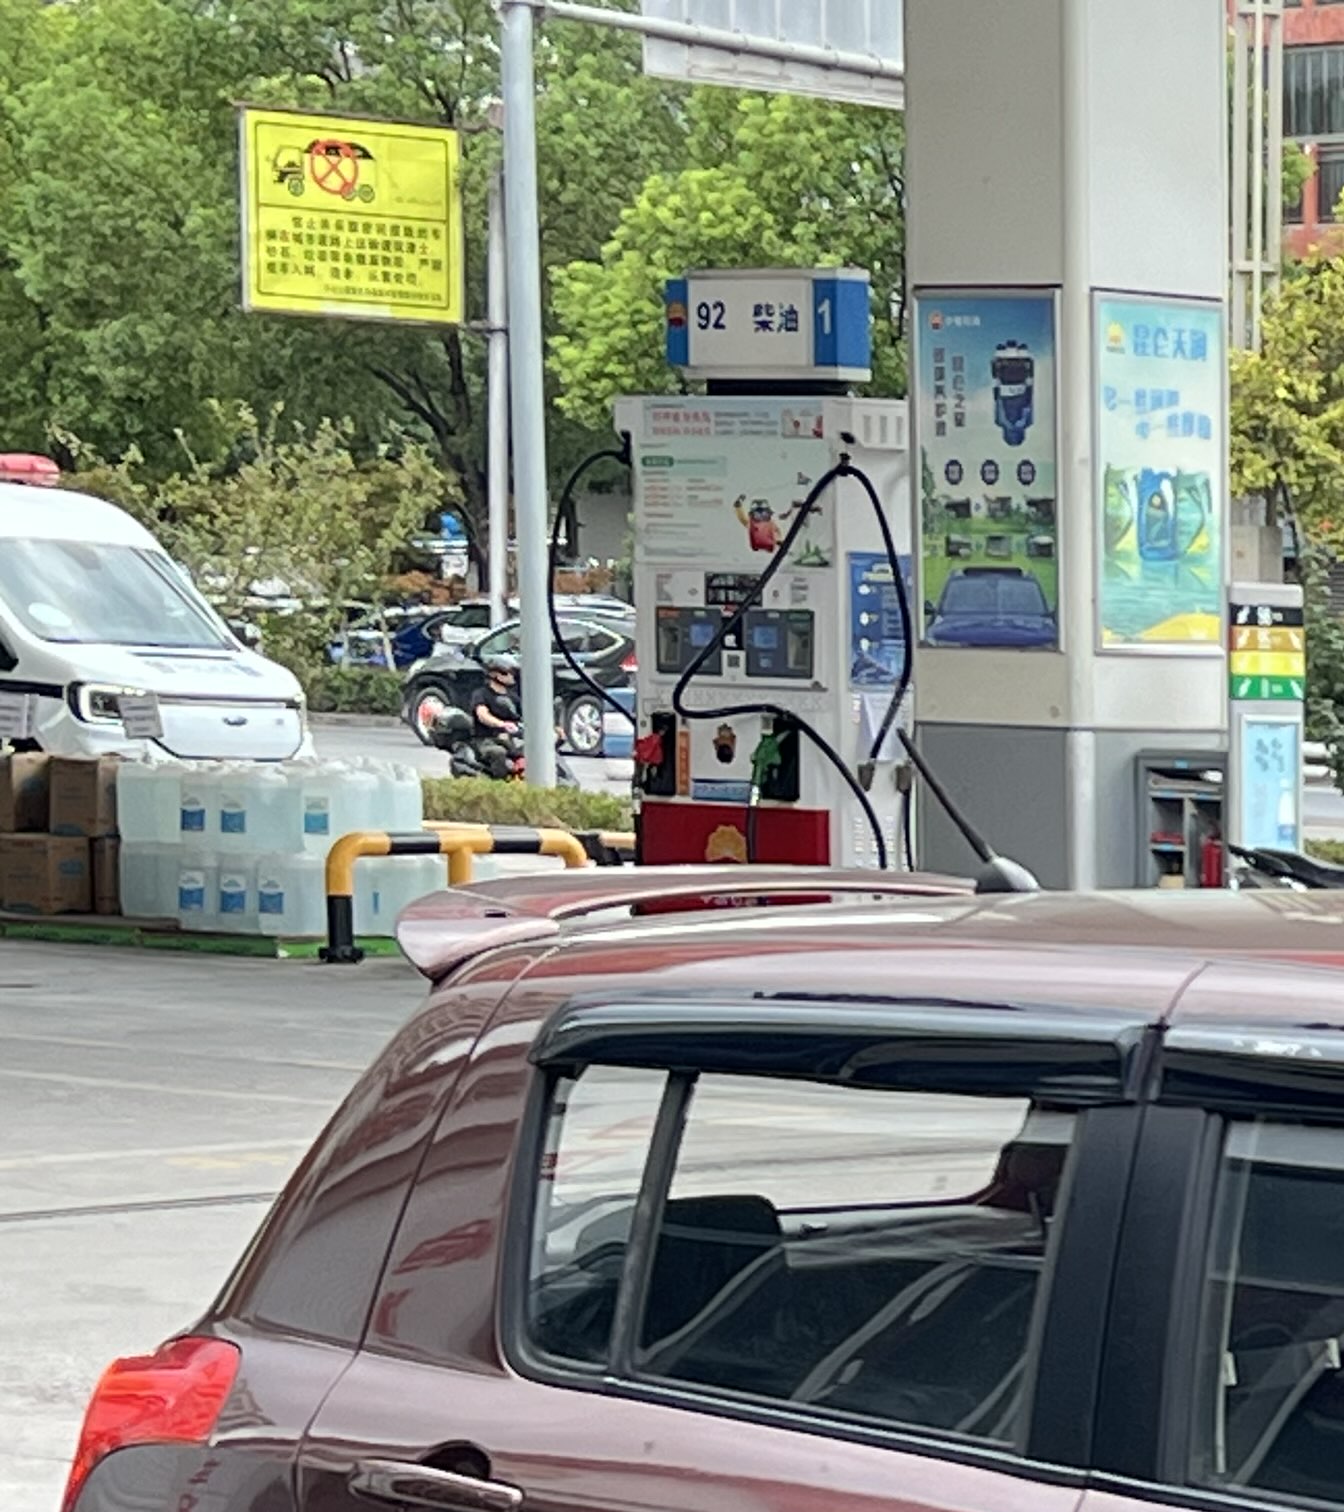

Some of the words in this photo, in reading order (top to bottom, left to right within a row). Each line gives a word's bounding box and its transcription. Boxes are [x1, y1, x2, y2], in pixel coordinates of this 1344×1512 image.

[696, 301, 726, 331] 92
[752, 303, 799, 333] 柴油
[818, 299, 831, 334] 1
